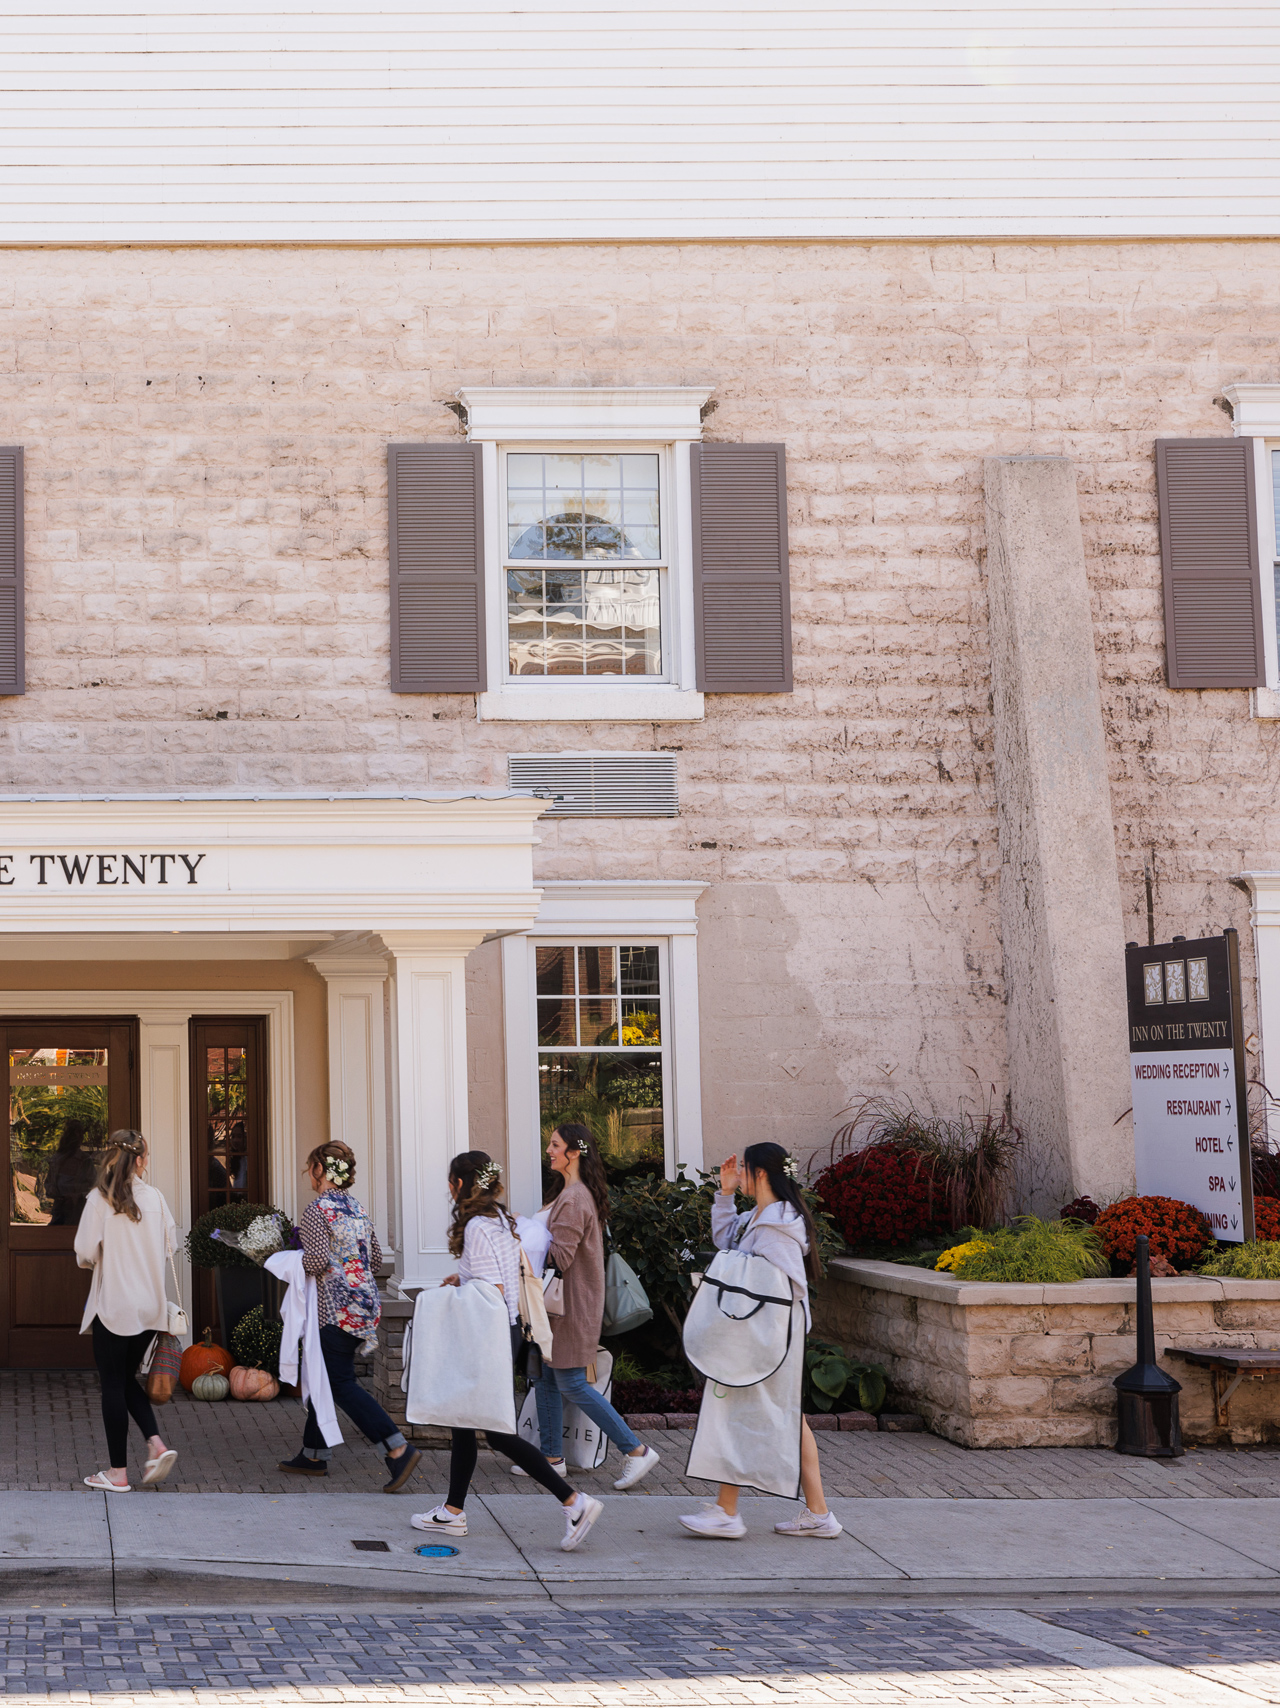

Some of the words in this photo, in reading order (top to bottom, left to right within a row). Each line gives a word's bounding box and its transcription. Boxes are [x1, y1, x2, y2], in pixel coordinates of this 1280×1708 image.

[29, 853, 207, 886] TWENTY
[1132, 1025, 1149, 1042] INN
[1150, 1024, 1164, 1041] ON
[1165, 1023, 1186, 1040] THE
[1186, 1020, 1228, 1039] TWENTY
[1134, 1063, 1171, 1080] WEDDING
[1172, 1062, 1220, 1079] RECEPTION
[1166, 1100, 1222, 1116] RESTAURANT
[1195, 1136, 1224, 1153] HOTEL
[1208, 1175, 1226, 1192] SPA
[1198, 1211, 1229, 1230] INING
[522, 1416, 593, 1442] AZIE
